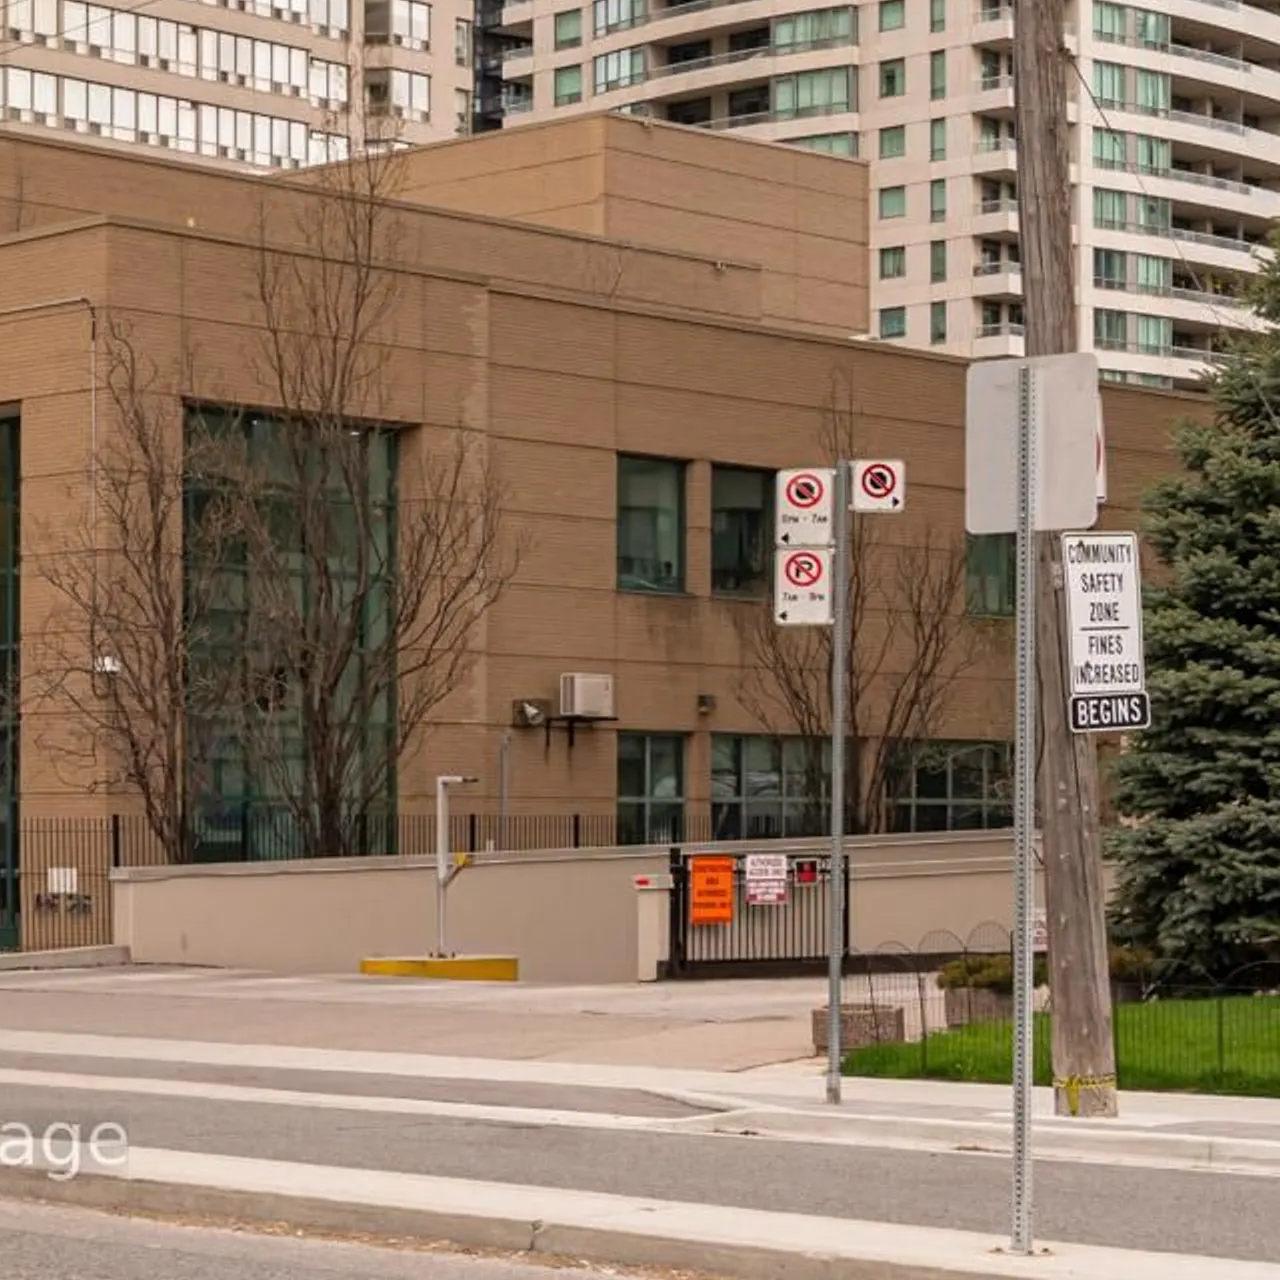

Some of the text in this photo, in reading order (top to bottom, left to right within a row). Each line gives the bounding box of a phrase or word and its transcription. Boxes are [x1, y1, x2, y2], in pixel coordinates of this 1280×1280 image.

[1068, 544, 1131, 564] COMMUNITY
[1081, 573, 1124, 593] SAFETY
[1089, 602, 1120, 622] ZONE
[1088, 636, 1123, 655] FINES
[1076, 663, 1139, 684] INCREASED
[1078, 697, 1141, 725] BEGINS
